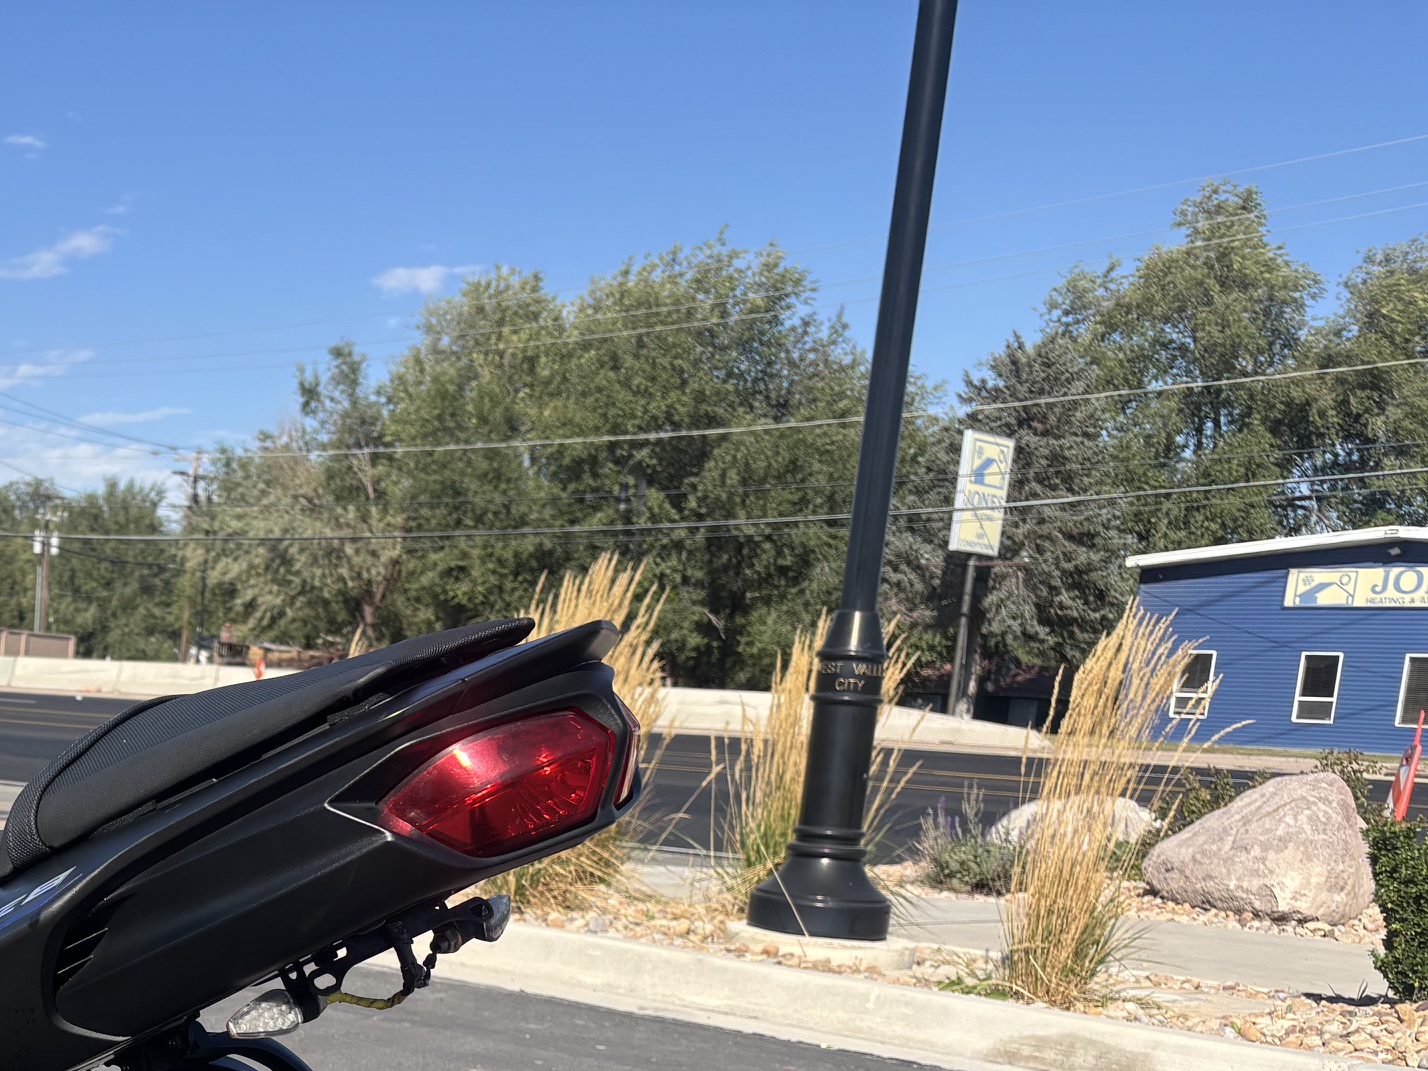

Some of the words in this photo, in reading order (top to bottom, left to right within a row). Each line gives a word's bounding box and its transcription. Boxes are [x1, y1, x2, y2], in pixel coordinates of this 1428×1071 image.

[1370, 567, 1428, 595] JO
[817, 661, 843, 675] EST
[834, 677, 866, 692] CITY
